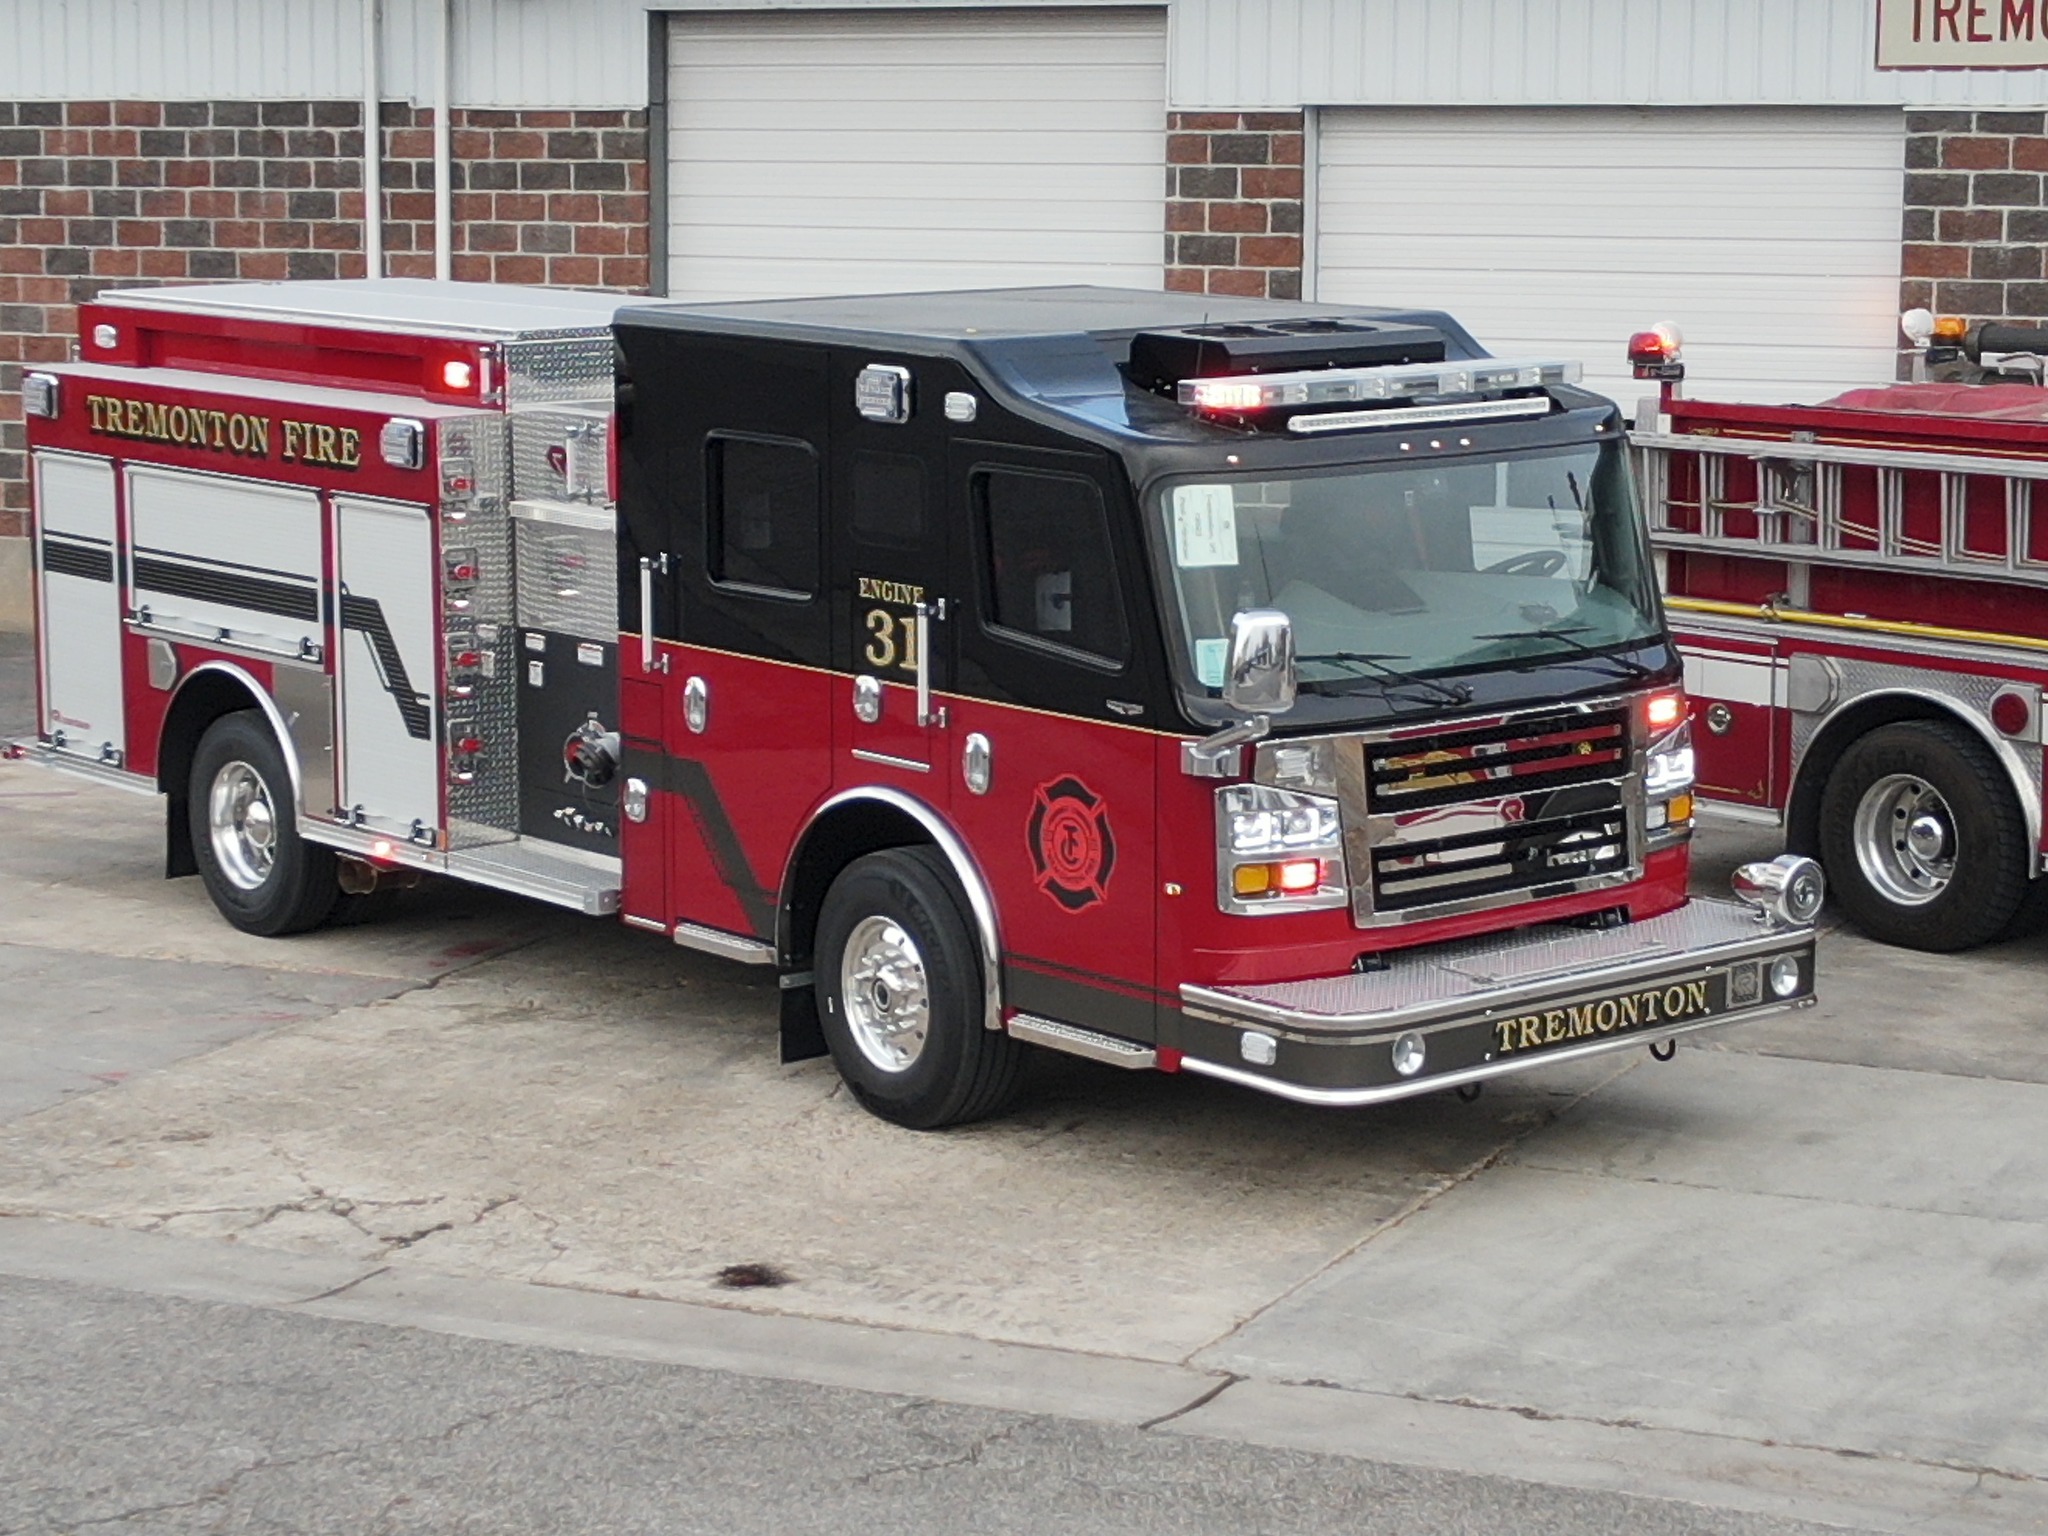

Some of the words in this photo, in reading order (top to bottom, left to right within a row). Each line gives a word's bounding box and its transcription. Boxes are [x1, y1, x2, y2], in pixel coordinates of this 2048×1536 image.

[1912, 0, 2048, 43] TREM
[87, 394, 270, 454] TREMONTON
[282, 419, 361, 467] FIRE
[858, 577, 924, 606] ENGINE
[866, 608, 918, 670] 31
[1495, 980, 1708, 1052] TREMONTON
